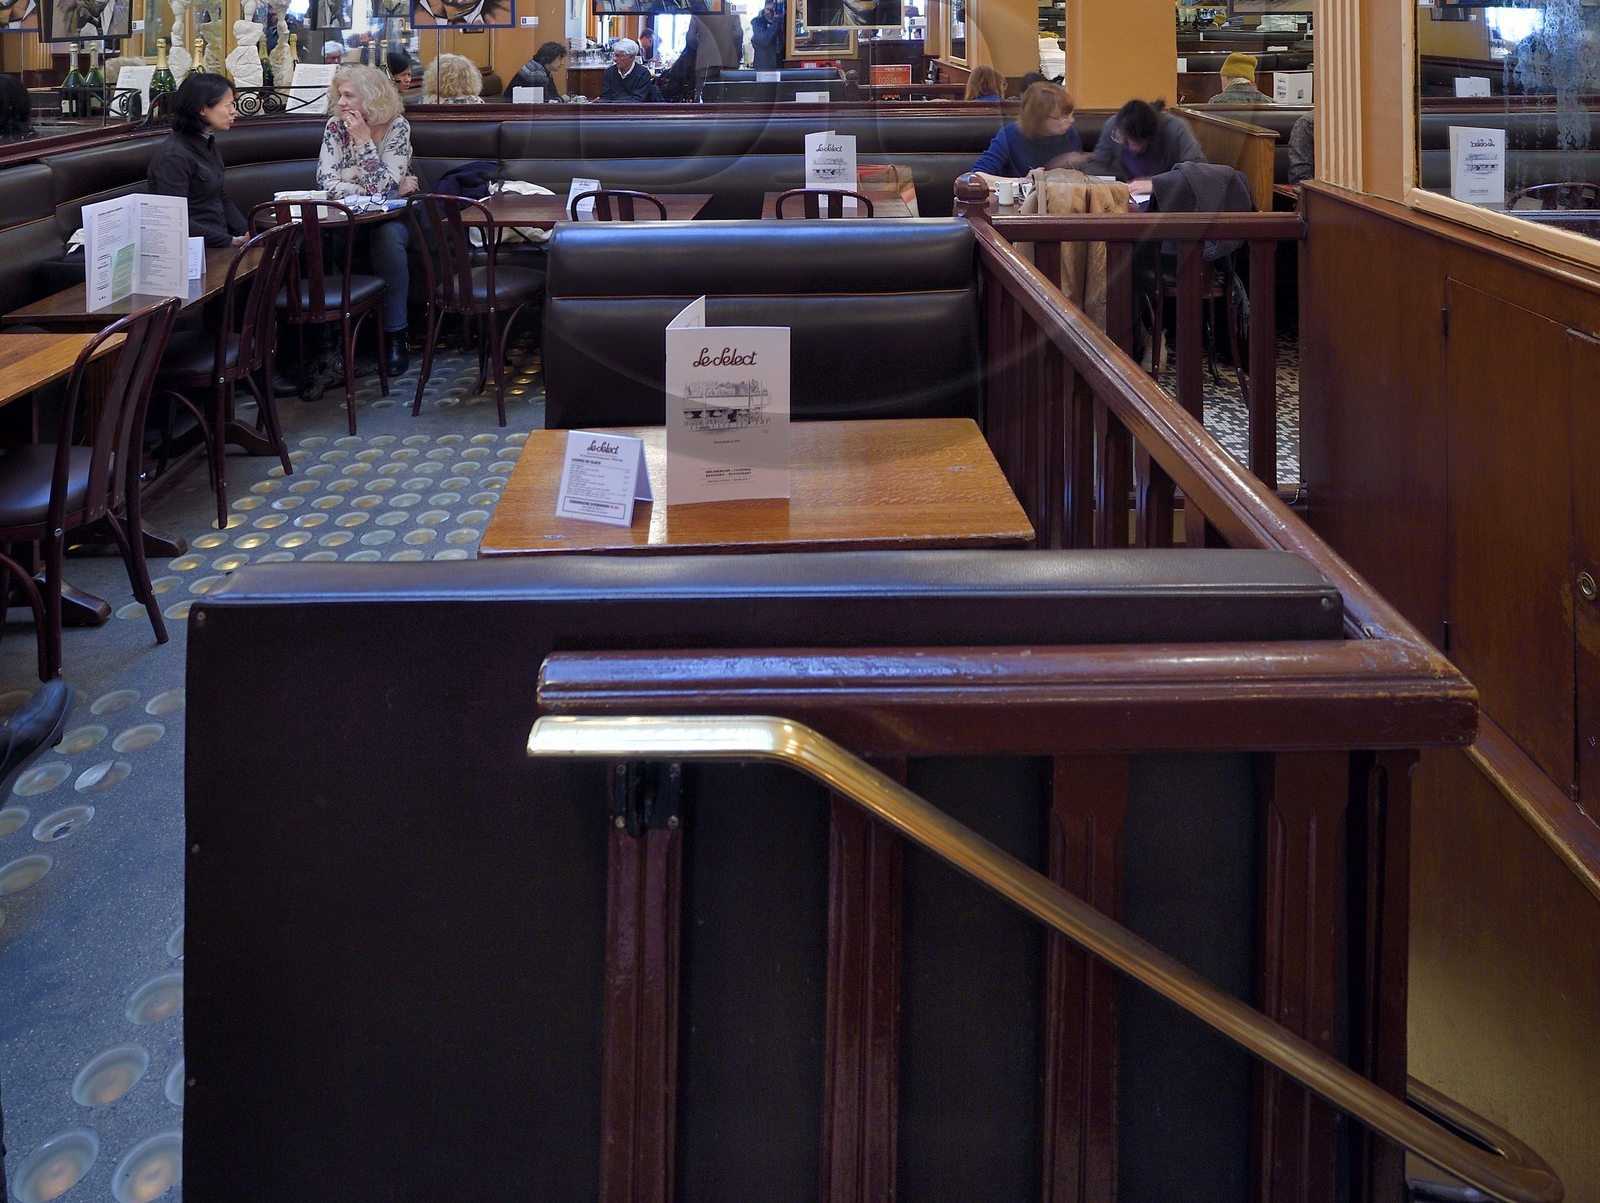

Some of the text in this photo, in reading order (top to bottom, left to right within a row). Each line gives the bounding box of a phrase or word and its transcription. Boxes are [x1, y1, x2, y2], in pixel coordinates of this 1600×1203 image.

[692, 347, 758, 367] Le Select
[597, 441, 619, 455] Select
